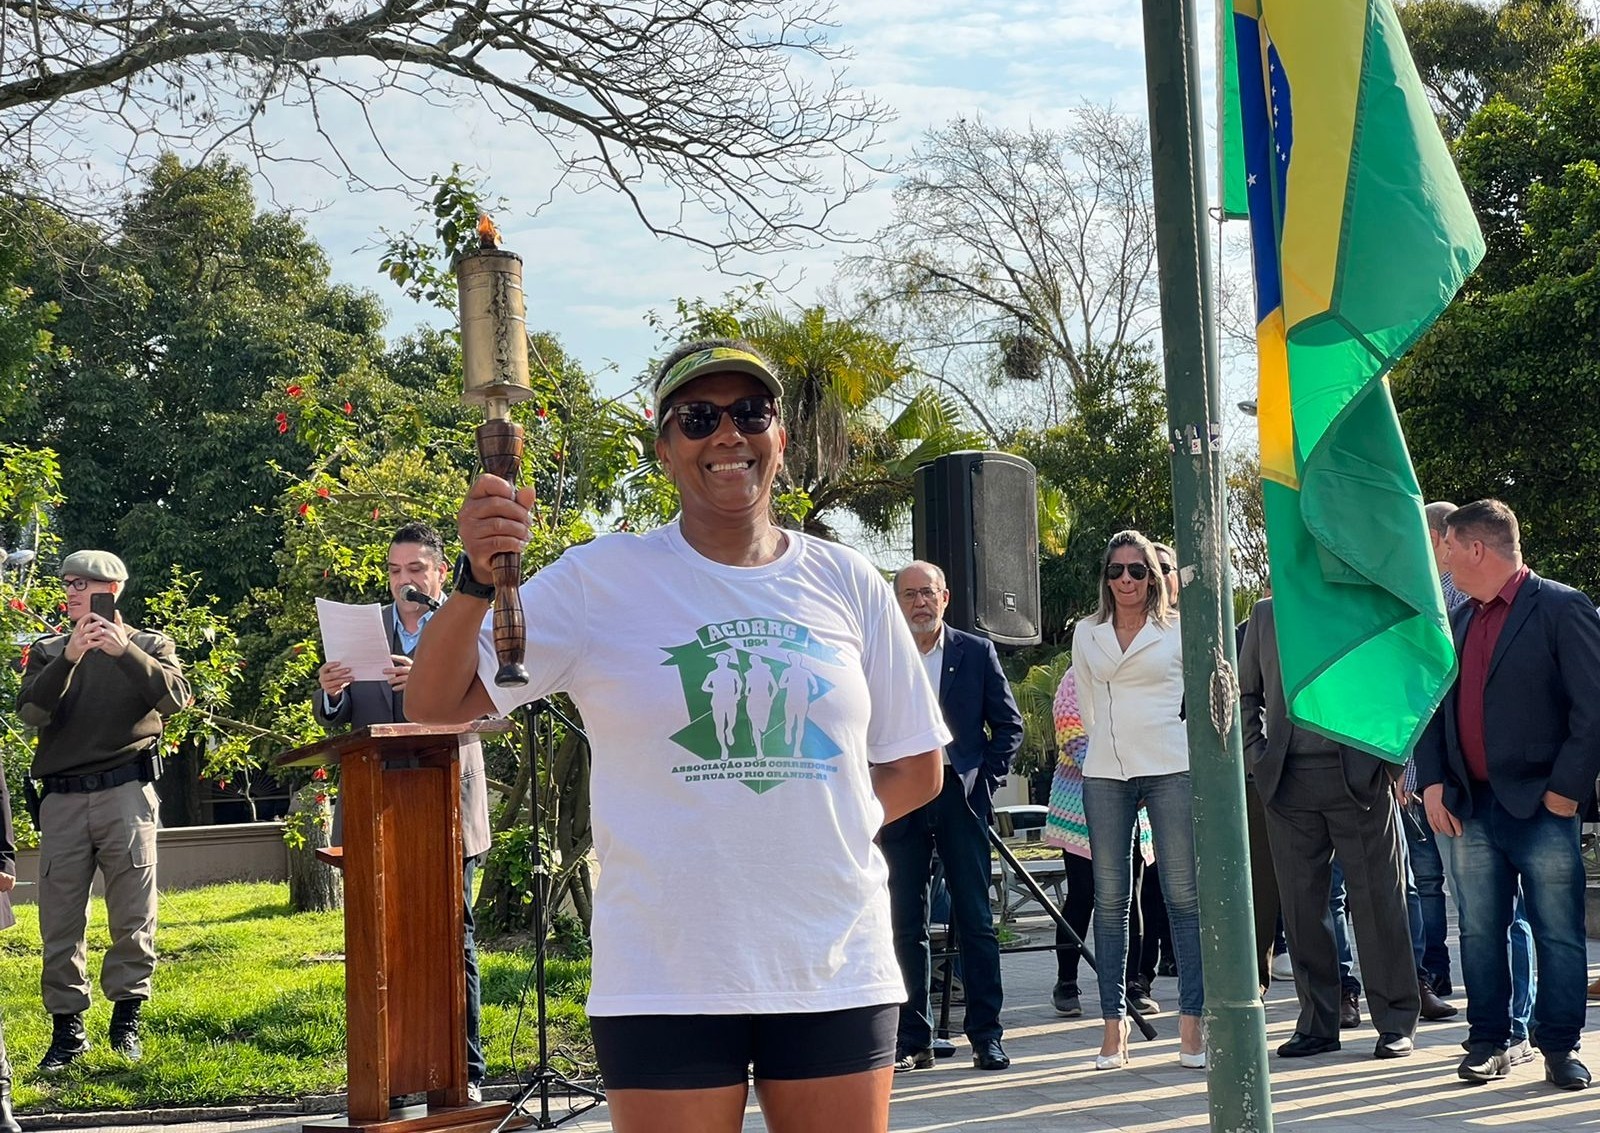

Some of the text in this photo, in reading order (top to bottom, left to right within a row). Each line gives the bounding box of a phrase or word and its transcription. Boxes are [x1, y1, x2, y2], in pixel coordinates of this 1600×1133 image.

[707, 619, 797, 642] ACORRG
[742, 638, 769, 648] 1994
[671, 760, 838, 773] ASSOCIAÇÃO DOS CORREDORES
[685, 774, 701, 782] DE
[702, 772, 725, 781] RUA
[727, 771, 743, 779] DO
[745, 770, 764, 778] RIO
